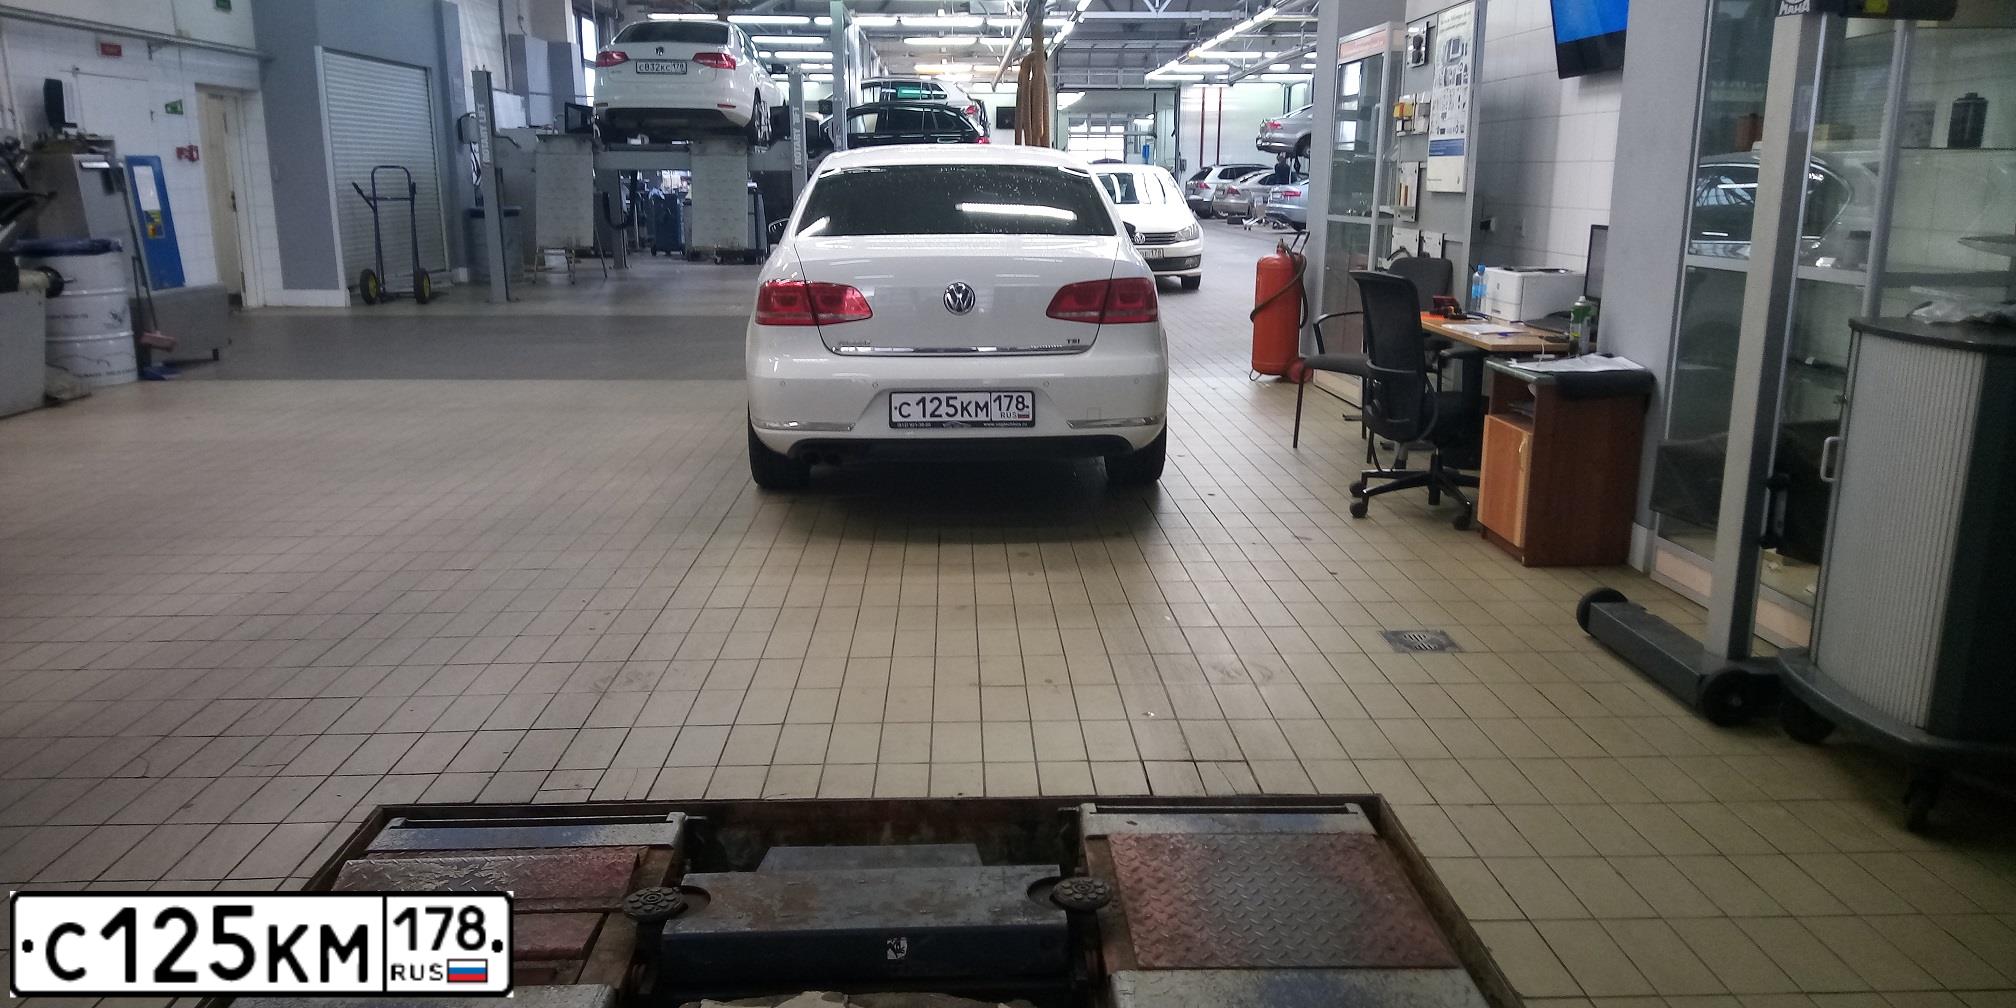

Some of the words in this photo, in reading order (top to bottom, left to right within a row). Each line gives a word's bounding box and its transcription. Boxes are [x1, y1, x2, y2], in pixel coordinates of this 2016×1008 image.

[898, 396, 989, 418] C125KM
[994, 395, 1025, 411] 178
[1001, 411, 1017, 419] RUS
